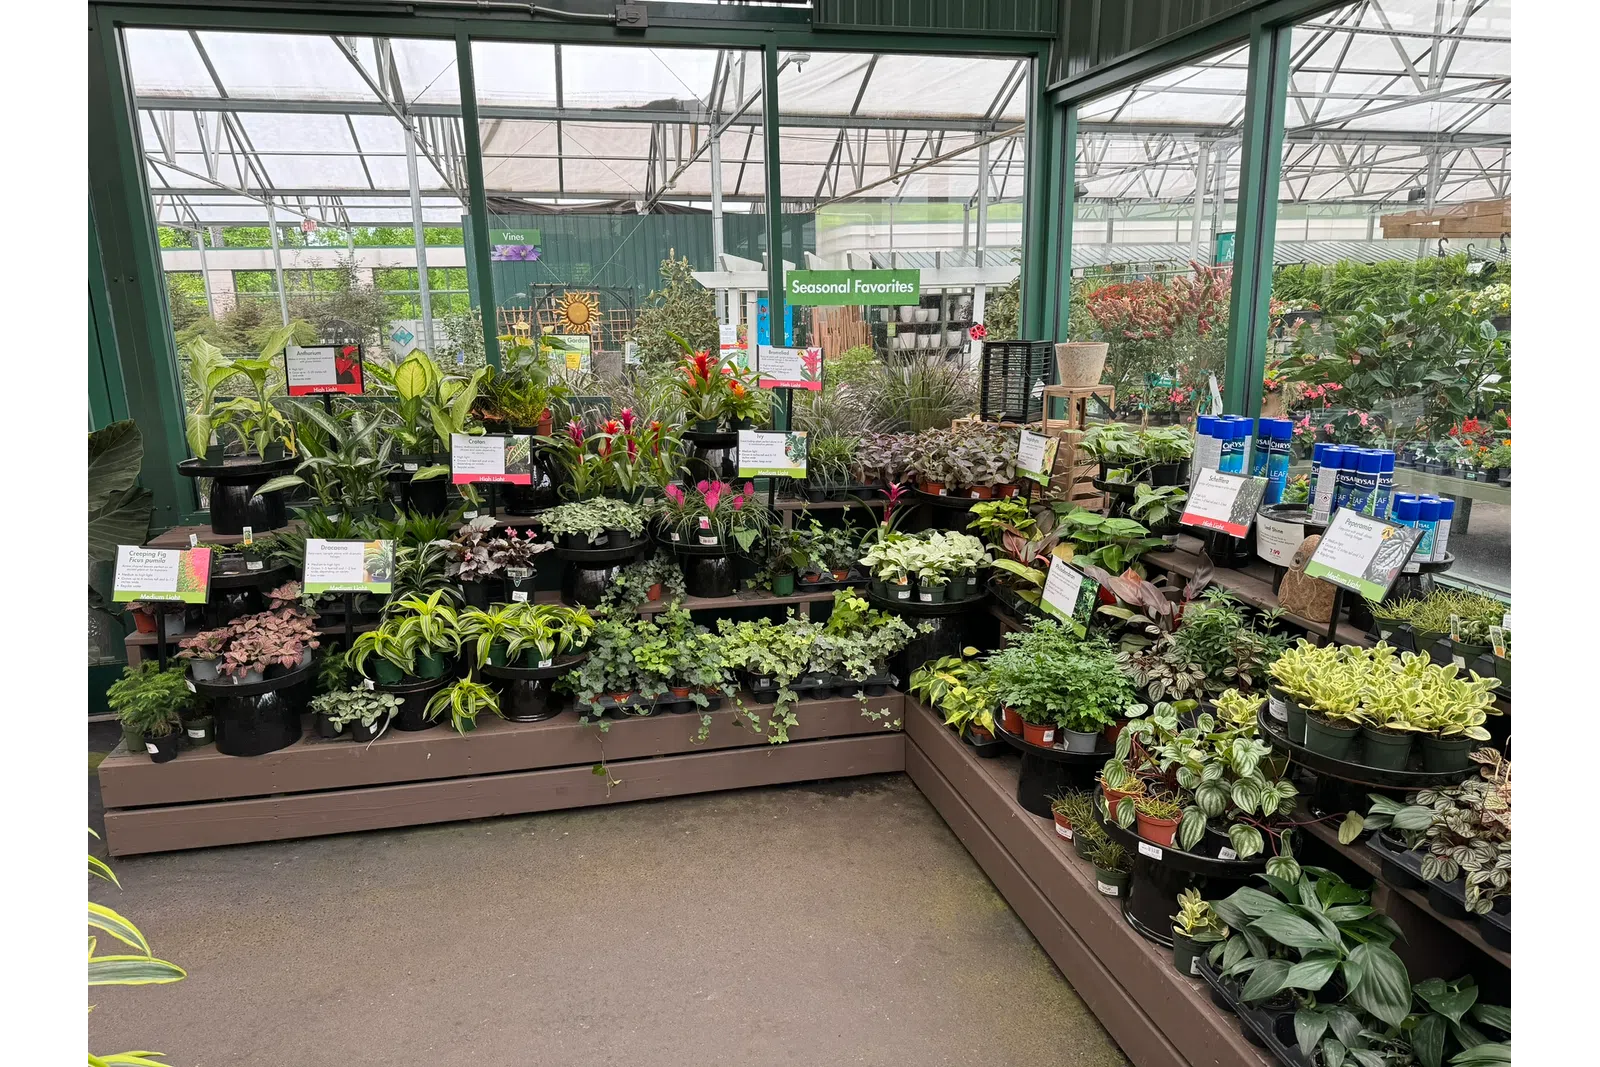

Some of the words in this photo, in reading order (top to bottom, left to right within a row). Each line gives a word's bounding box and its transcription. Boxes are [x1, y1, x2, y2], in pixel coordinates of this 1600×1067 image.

[502, 232, 524, 240] Vines
[792, 278, 850, 294] Seasonal
[854, 278, 914, 294] Favorites
[1209, 475, 1230, 484] Schefflera
[1344, 518, 1372, 532] Peperomia
[1326, 571, 1348, 586] Medium
[1347, 578, 1362, 590] Light
